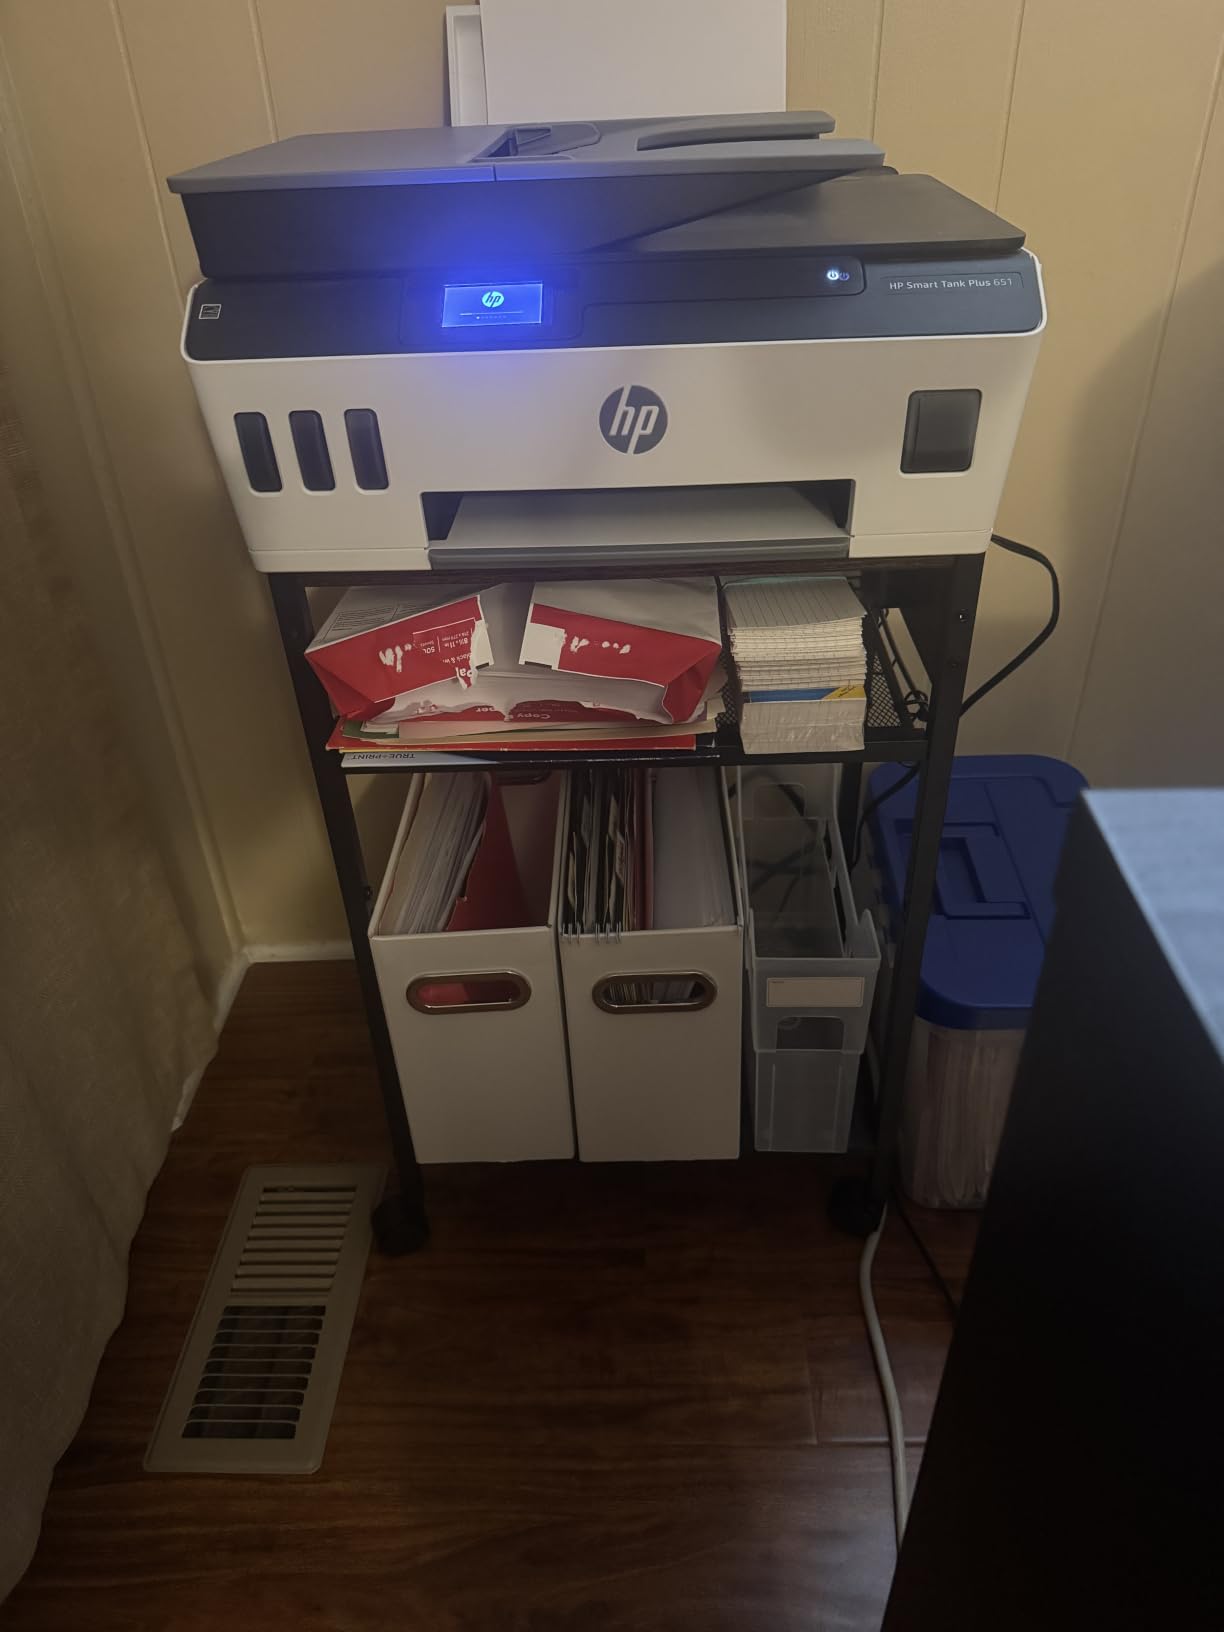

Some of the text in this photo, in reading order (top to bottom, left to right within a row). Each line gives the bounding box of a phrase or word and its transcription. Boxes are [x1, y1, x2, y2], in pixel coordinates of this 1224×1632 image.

[889, 278, 1012, 290] HP Smart Tank Plus 651
[483, 291, 504, 308] hp
[604, 385, 663, 455] hp
